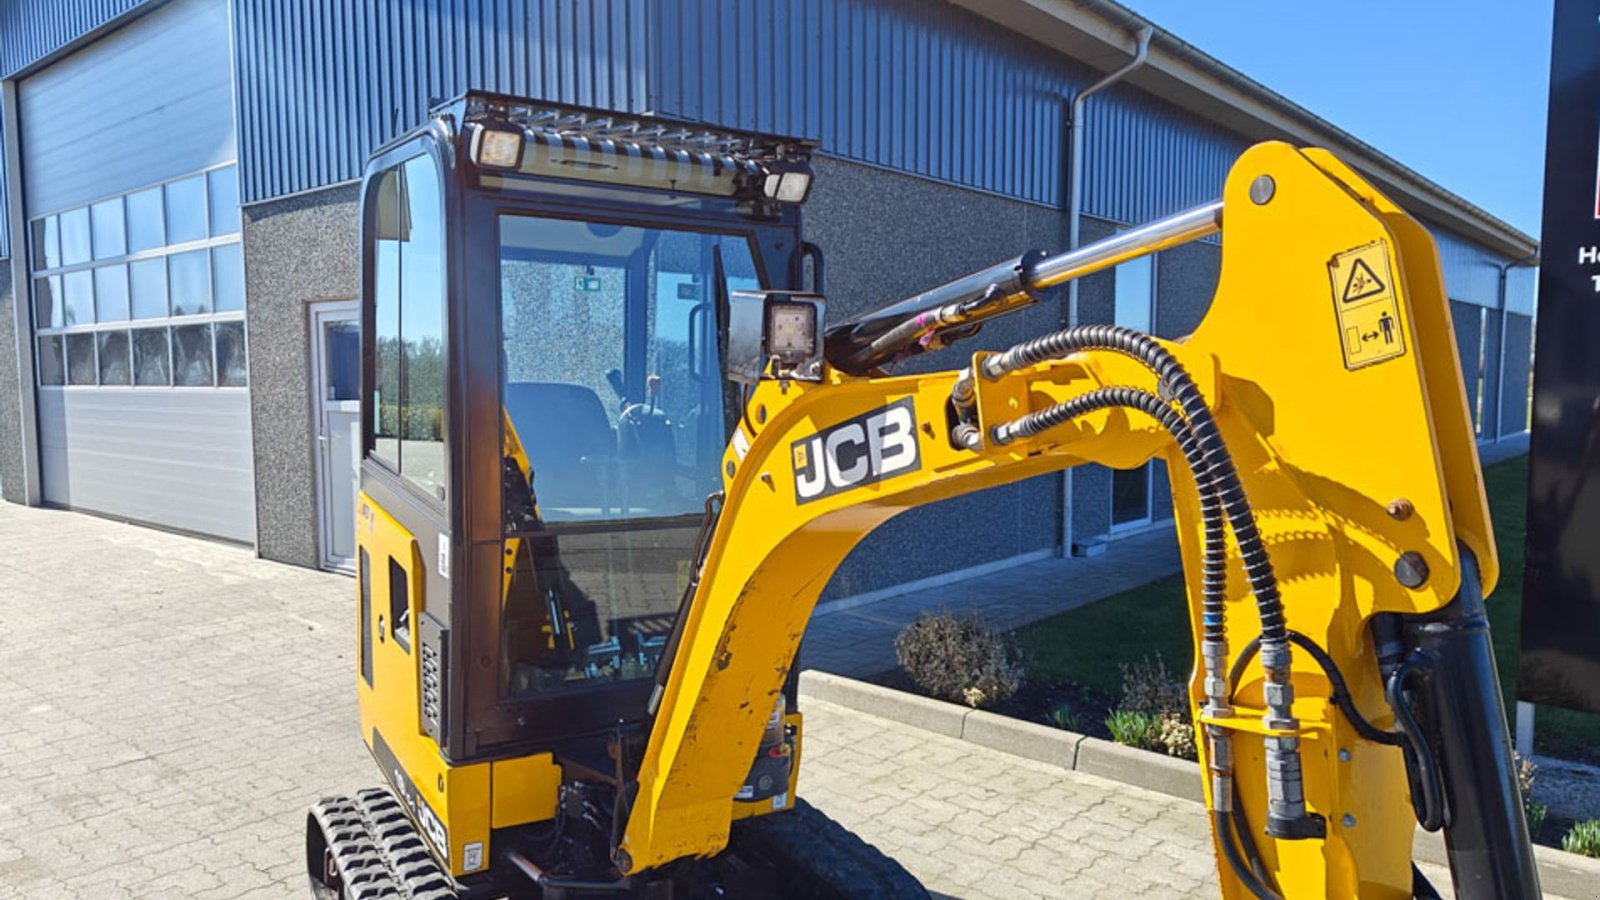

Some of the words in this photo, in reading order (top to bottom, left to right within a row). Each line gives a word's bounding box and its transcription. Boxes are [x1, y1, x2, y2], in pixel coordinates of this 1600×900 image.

[1578, 246, 1600, 264] H
[795, 406, 917, 498] JCB
[417, 798, 448, 859] JCB
